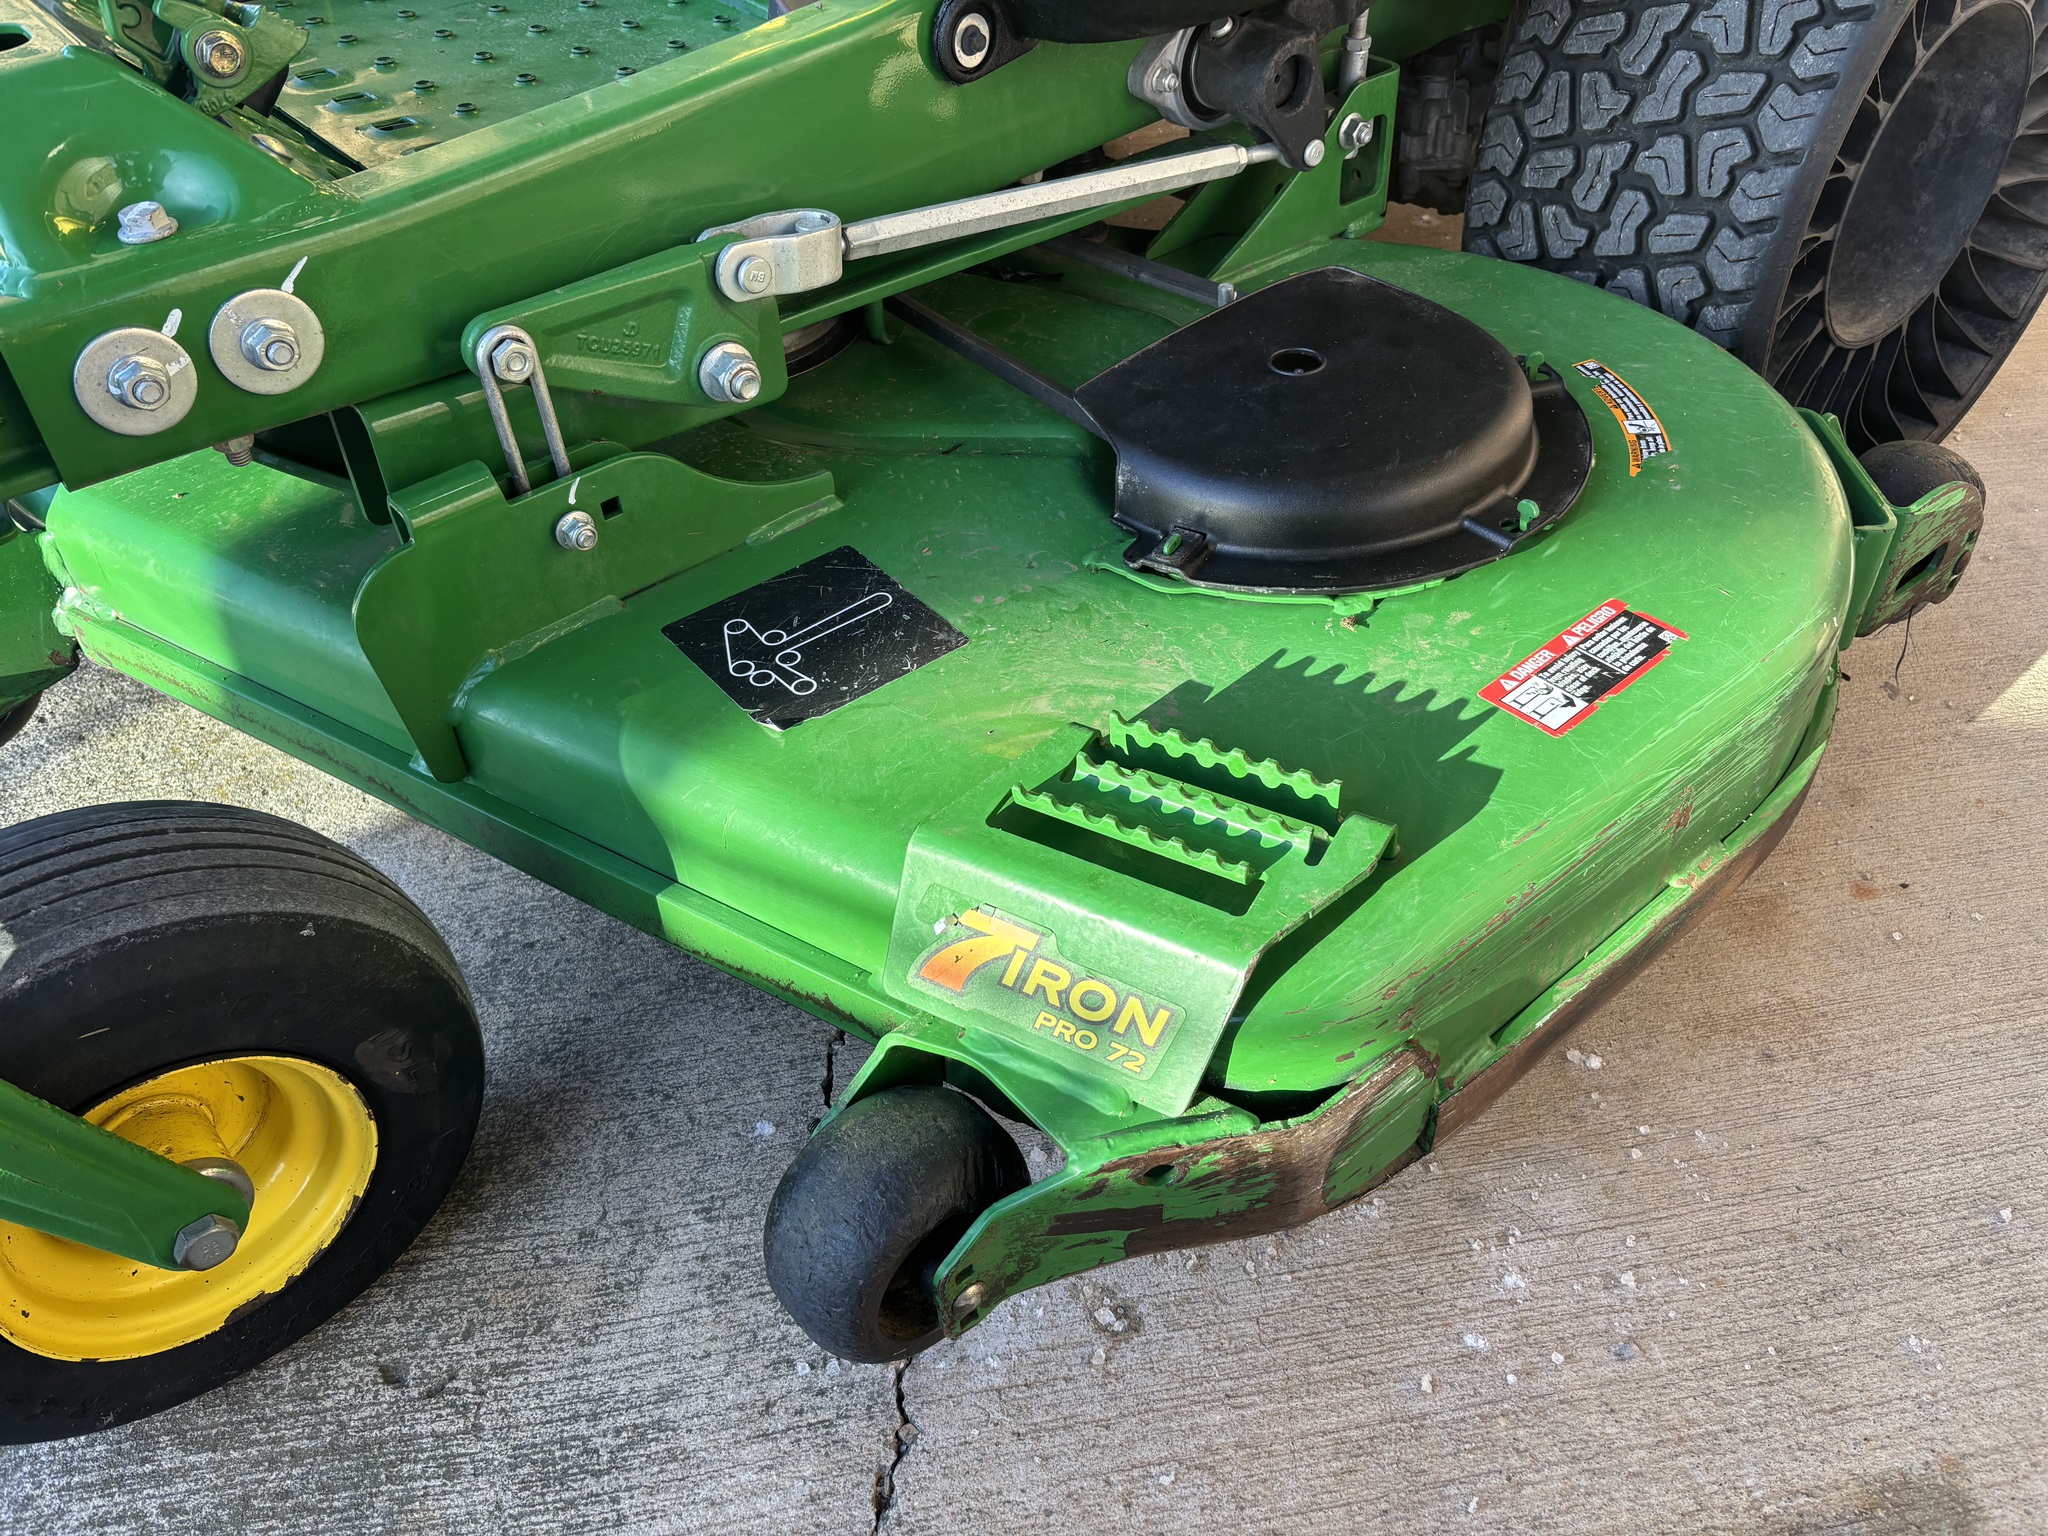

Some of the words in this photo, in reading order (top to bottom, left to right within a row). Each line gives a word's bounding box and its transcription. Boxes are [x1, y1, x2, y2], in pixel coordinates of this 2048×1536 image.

[1628, 439, 1640, 462] WARNING
[1570, 605, 1616, 636] PELIGRO
[1578, 639, 1595, 650] Para
[1591, 629, 1608, 641] evitar
[1603, 616, 1628, 632] lesiones
[1588, 636, 1614, 654] causadas
[1508, 649, 1556, 680] DANGER
[1546, 659, 1566, 673] avoid
[1559, 649, 1581, 663] injury
[1564, 679, 1582, 692] clear
[1584, 666, 1601, 677] deck
[1034, 1010, 1098, 1050] PRO
[1106, 1041, 1147, 1074] 72
